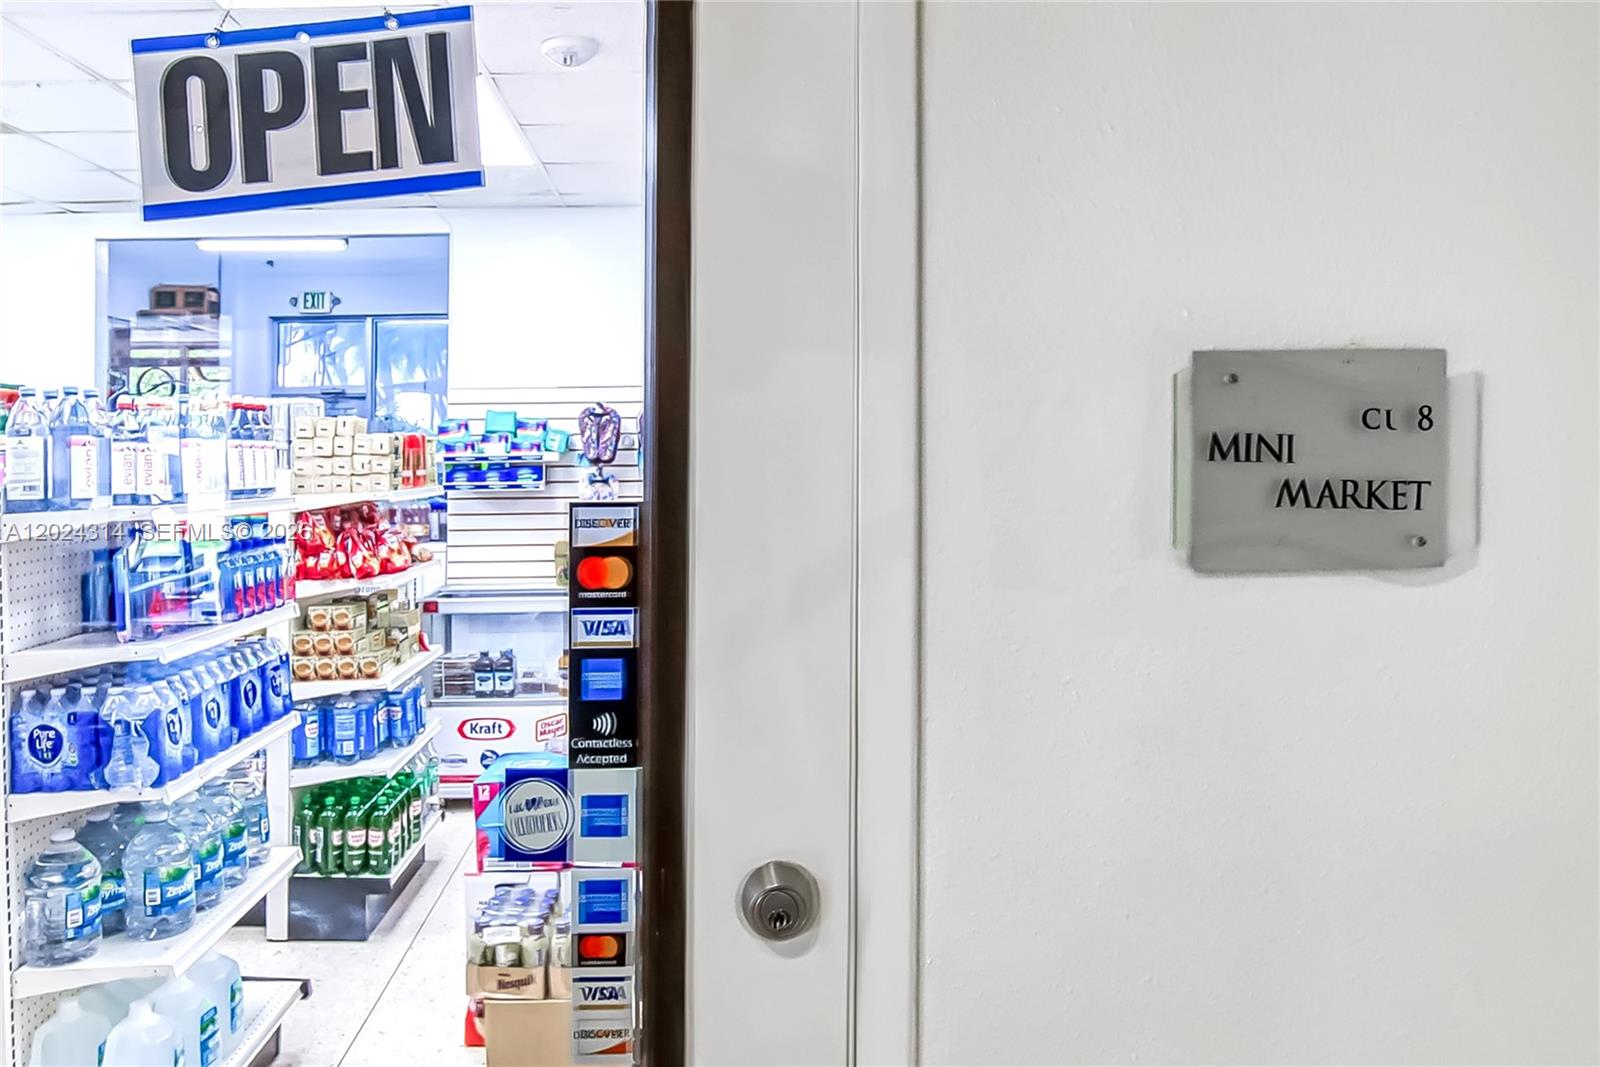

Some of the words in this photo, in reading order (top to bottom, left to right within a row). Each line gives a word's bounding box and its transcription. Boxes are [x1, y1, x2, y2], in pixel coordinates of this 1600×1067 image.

[160, 32, 458, 193] OPEN
[303, 292, 326, 309] EXIT
[1417, 404, 1434, 431] 8
[1207, 431, 1296, 464] MINI
[123, 453, 133, 486] evian
[144, 453, 153, 487] evian
[1274, 478, 1432, 511] MARKET
[581, 619, 629, 637] VISA
[469, 721, 503, 735] Kraft
[539, 725, 566, 738] Mayer
[540, 717, 564, 730] Oscar
[32, 729, 56, 739] Pure
[570, 737, 633, 749] Contactless
[576, 753, 628, 766] Accepted
[477, 785, 490, 801] 12
[580, 986, 626, 1001] VISA
[573, 1029, 630, 1040] DISCOVER
